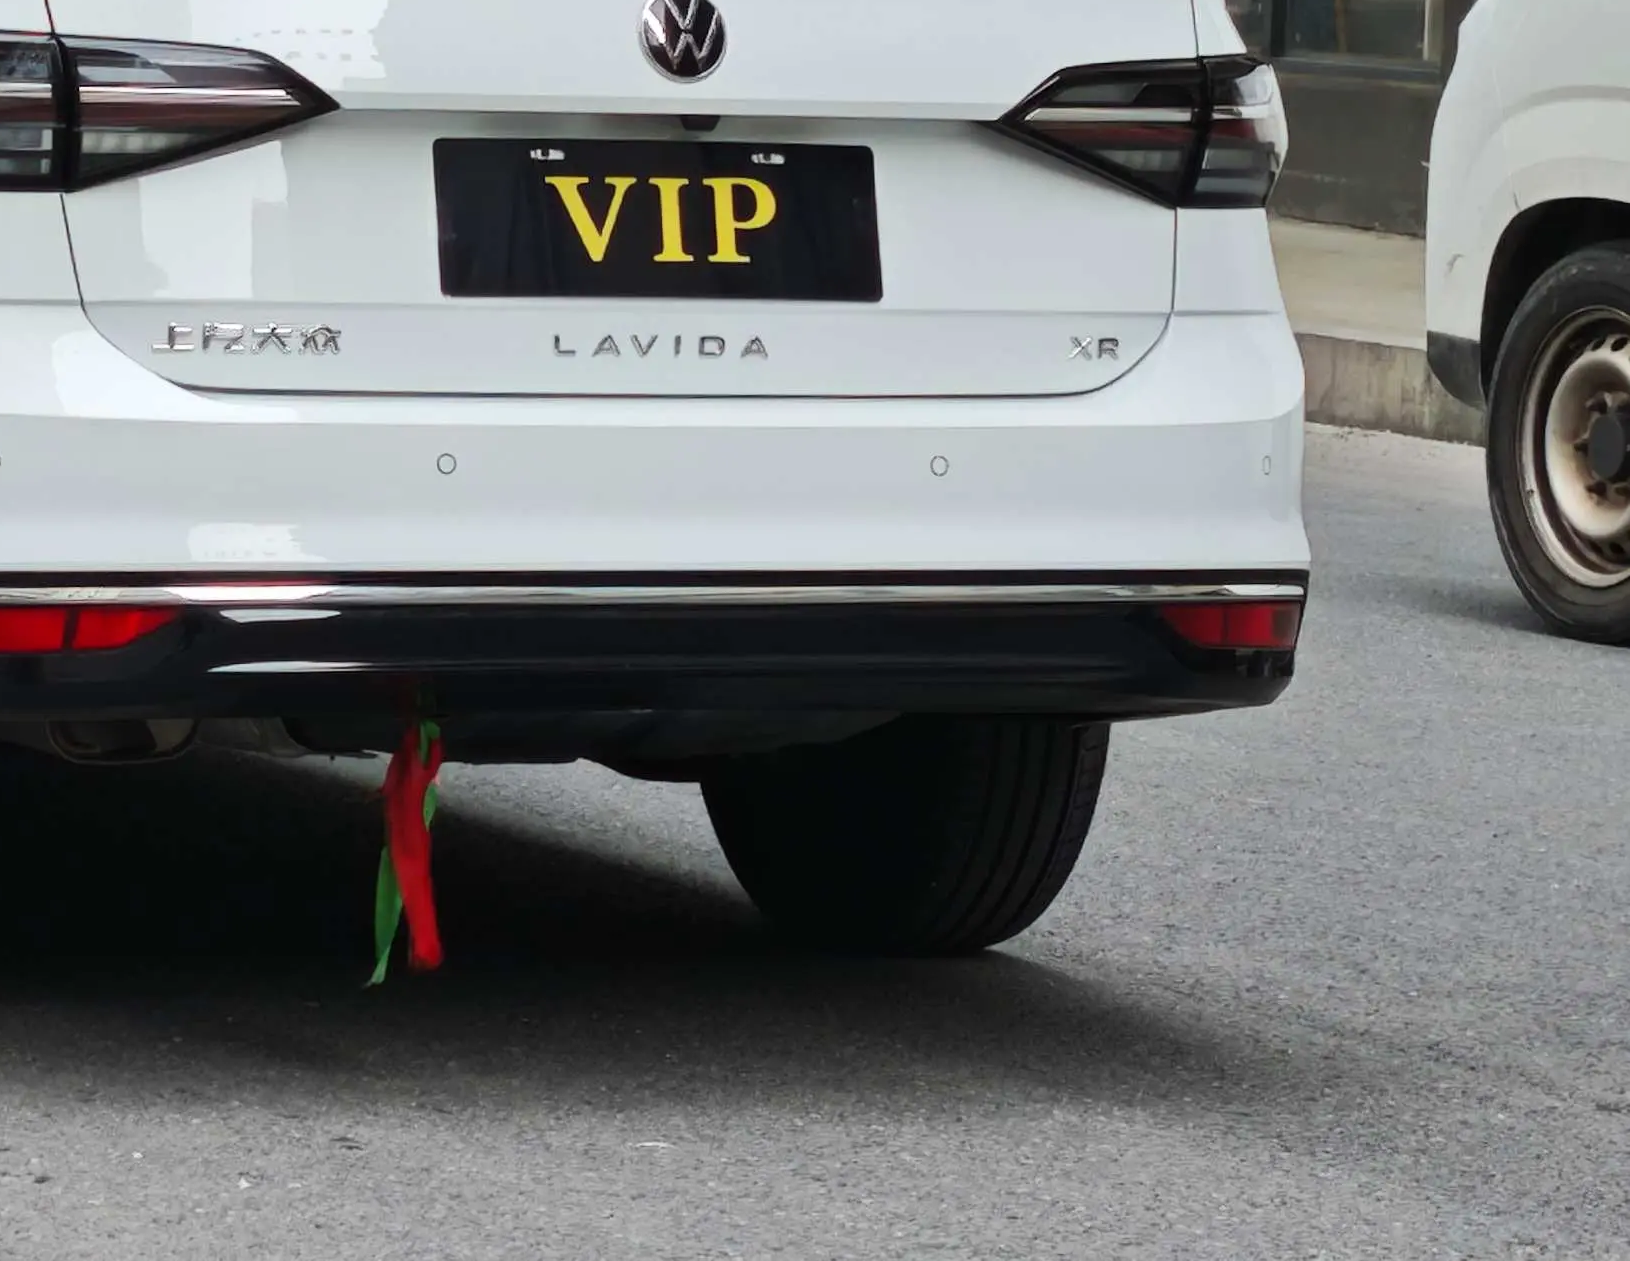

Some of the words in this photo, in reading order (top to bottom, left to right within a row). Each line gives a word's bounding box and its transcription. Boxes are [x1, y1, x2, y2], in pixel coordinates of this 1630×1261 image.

[543, 176, 778, 263] VIP
[554, 333, 769, 358] LAVIDA
[1067, 336, 1119, 360] XR
